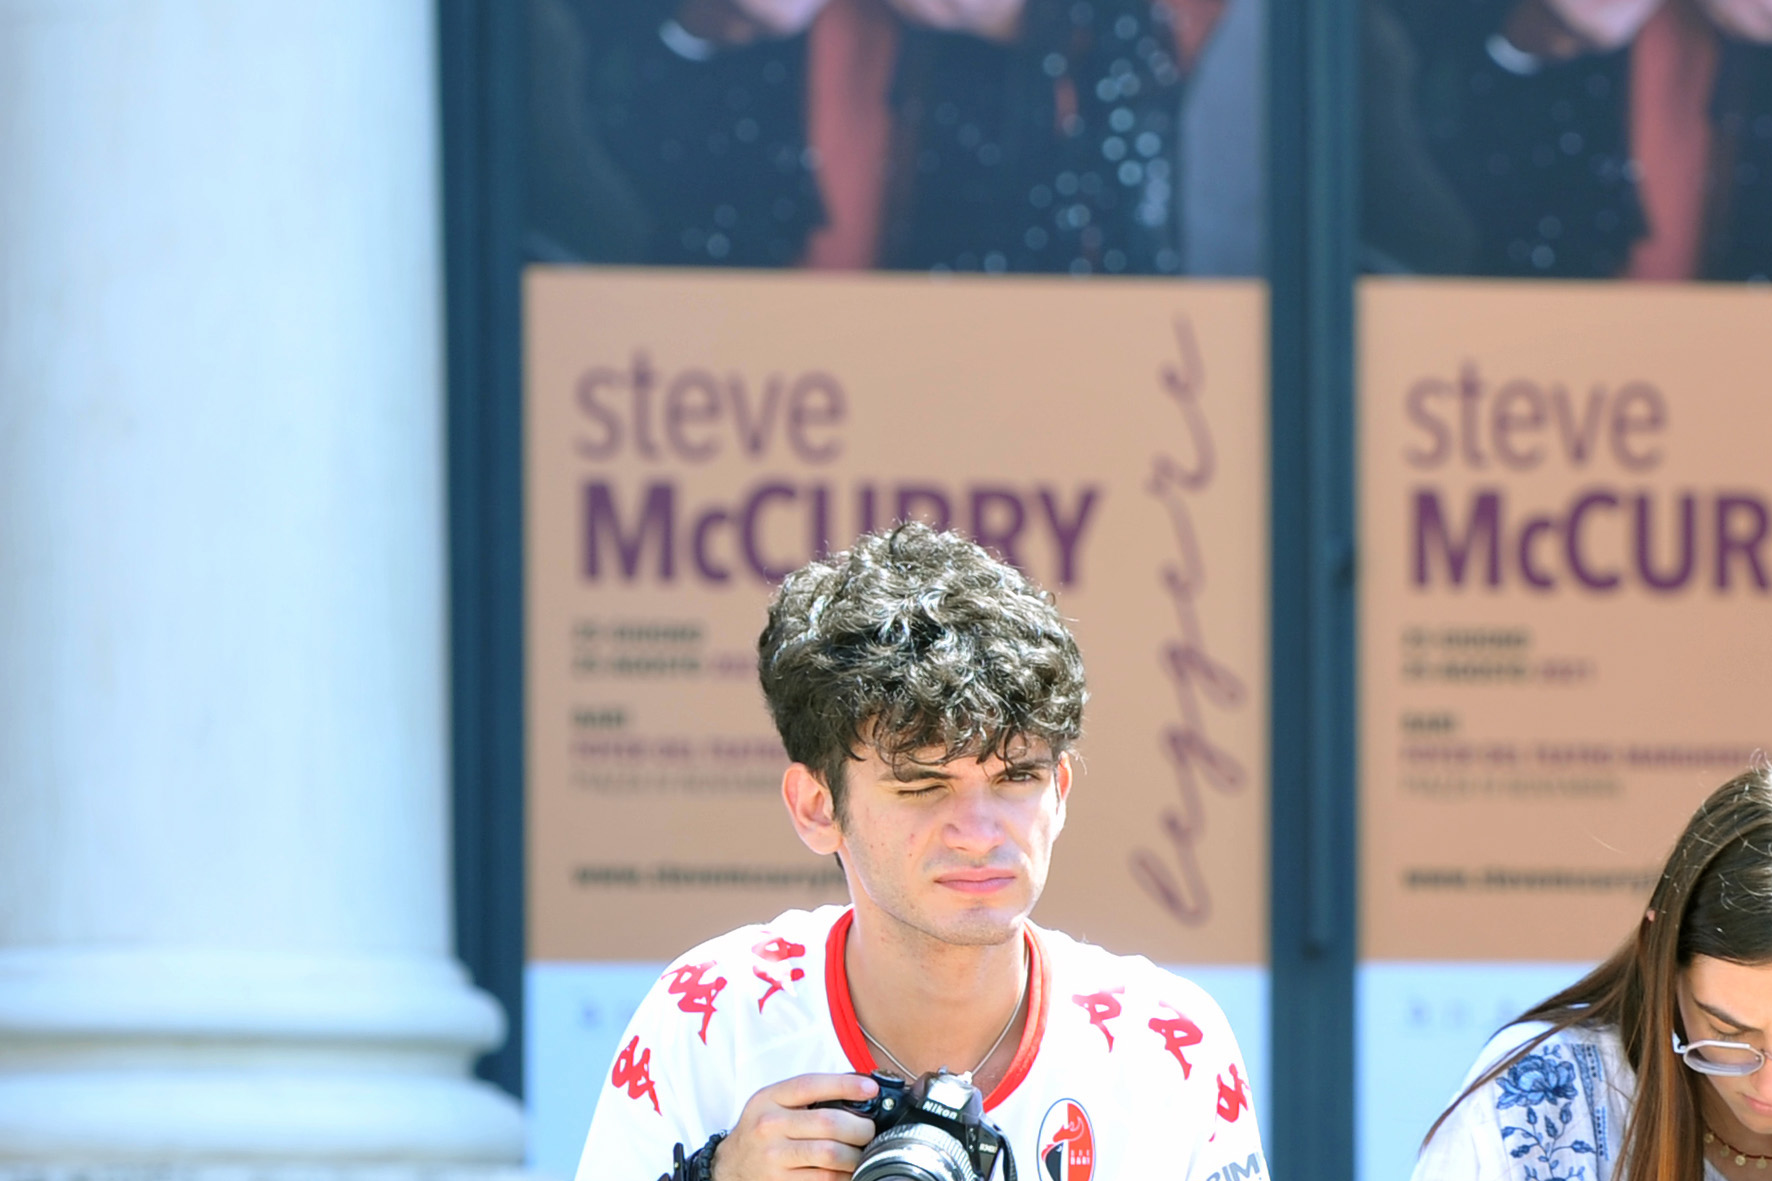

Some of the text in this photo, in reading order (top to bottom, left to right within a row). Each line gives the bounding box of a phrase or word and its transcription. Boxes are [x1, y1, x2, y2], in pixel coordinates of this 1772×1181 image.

[572, 350, 848, 464] steve
[1402, 358, 1668, 471] steve
[922, 1100, 958, 1121] Nikon
